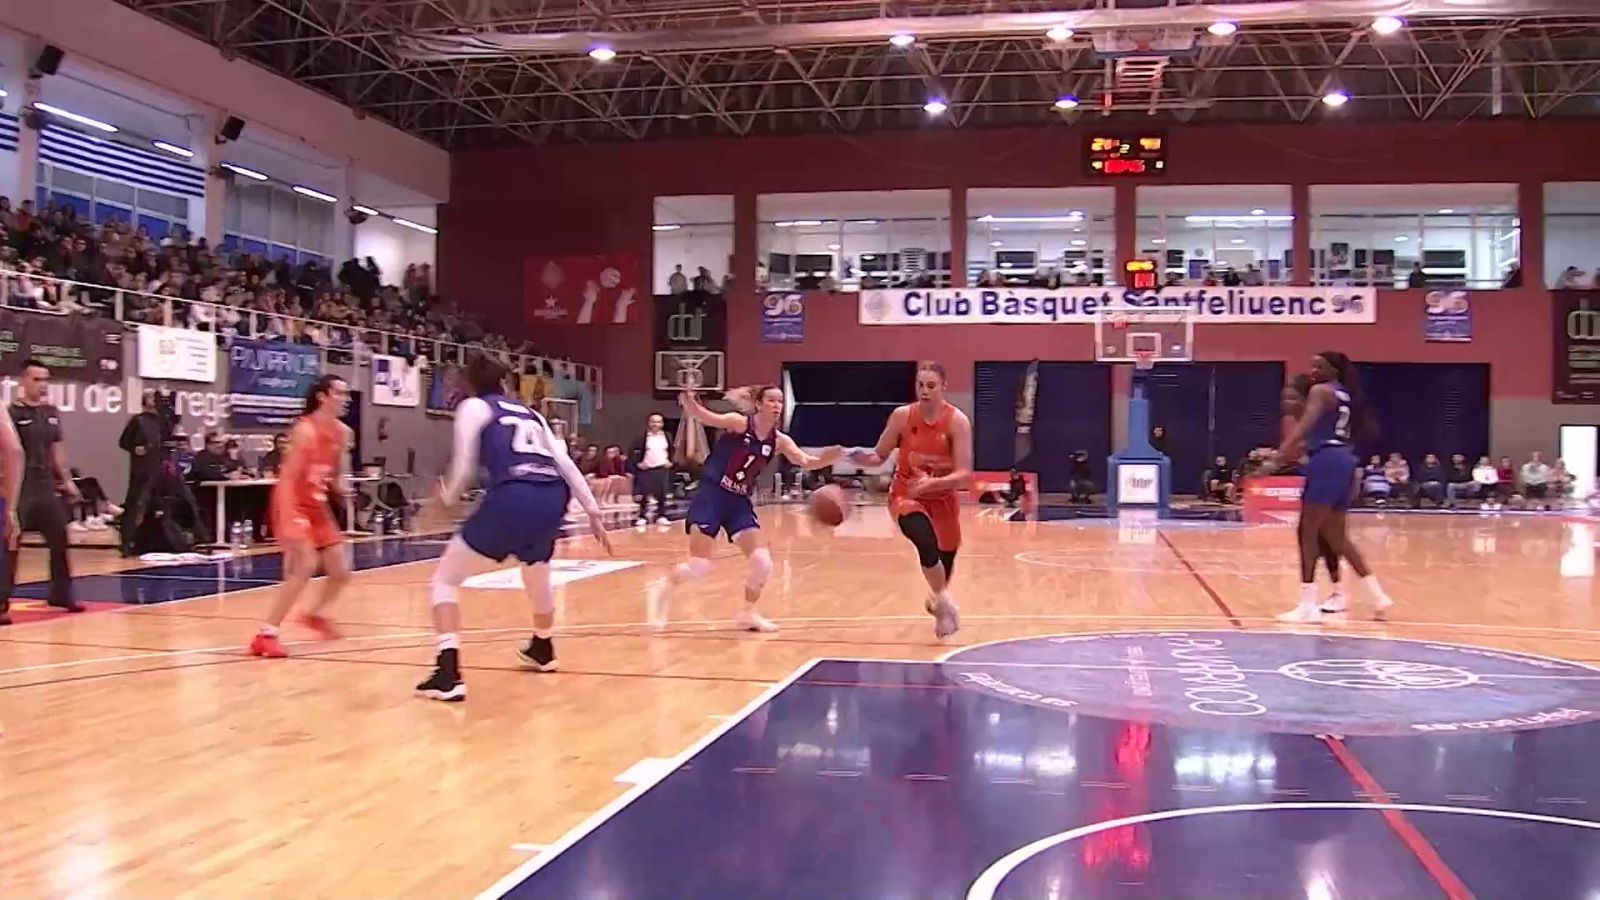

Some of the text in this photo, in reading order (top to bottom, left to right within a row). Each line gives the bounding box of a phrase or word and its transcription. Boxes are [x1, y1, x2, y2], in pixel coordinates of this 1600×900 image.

[763, 293, 803, 316] 96
[904, 290, 971, 316] Club
[981, 289, 1113, 321] Bàsquet
[84, 382, 122, 414] de
